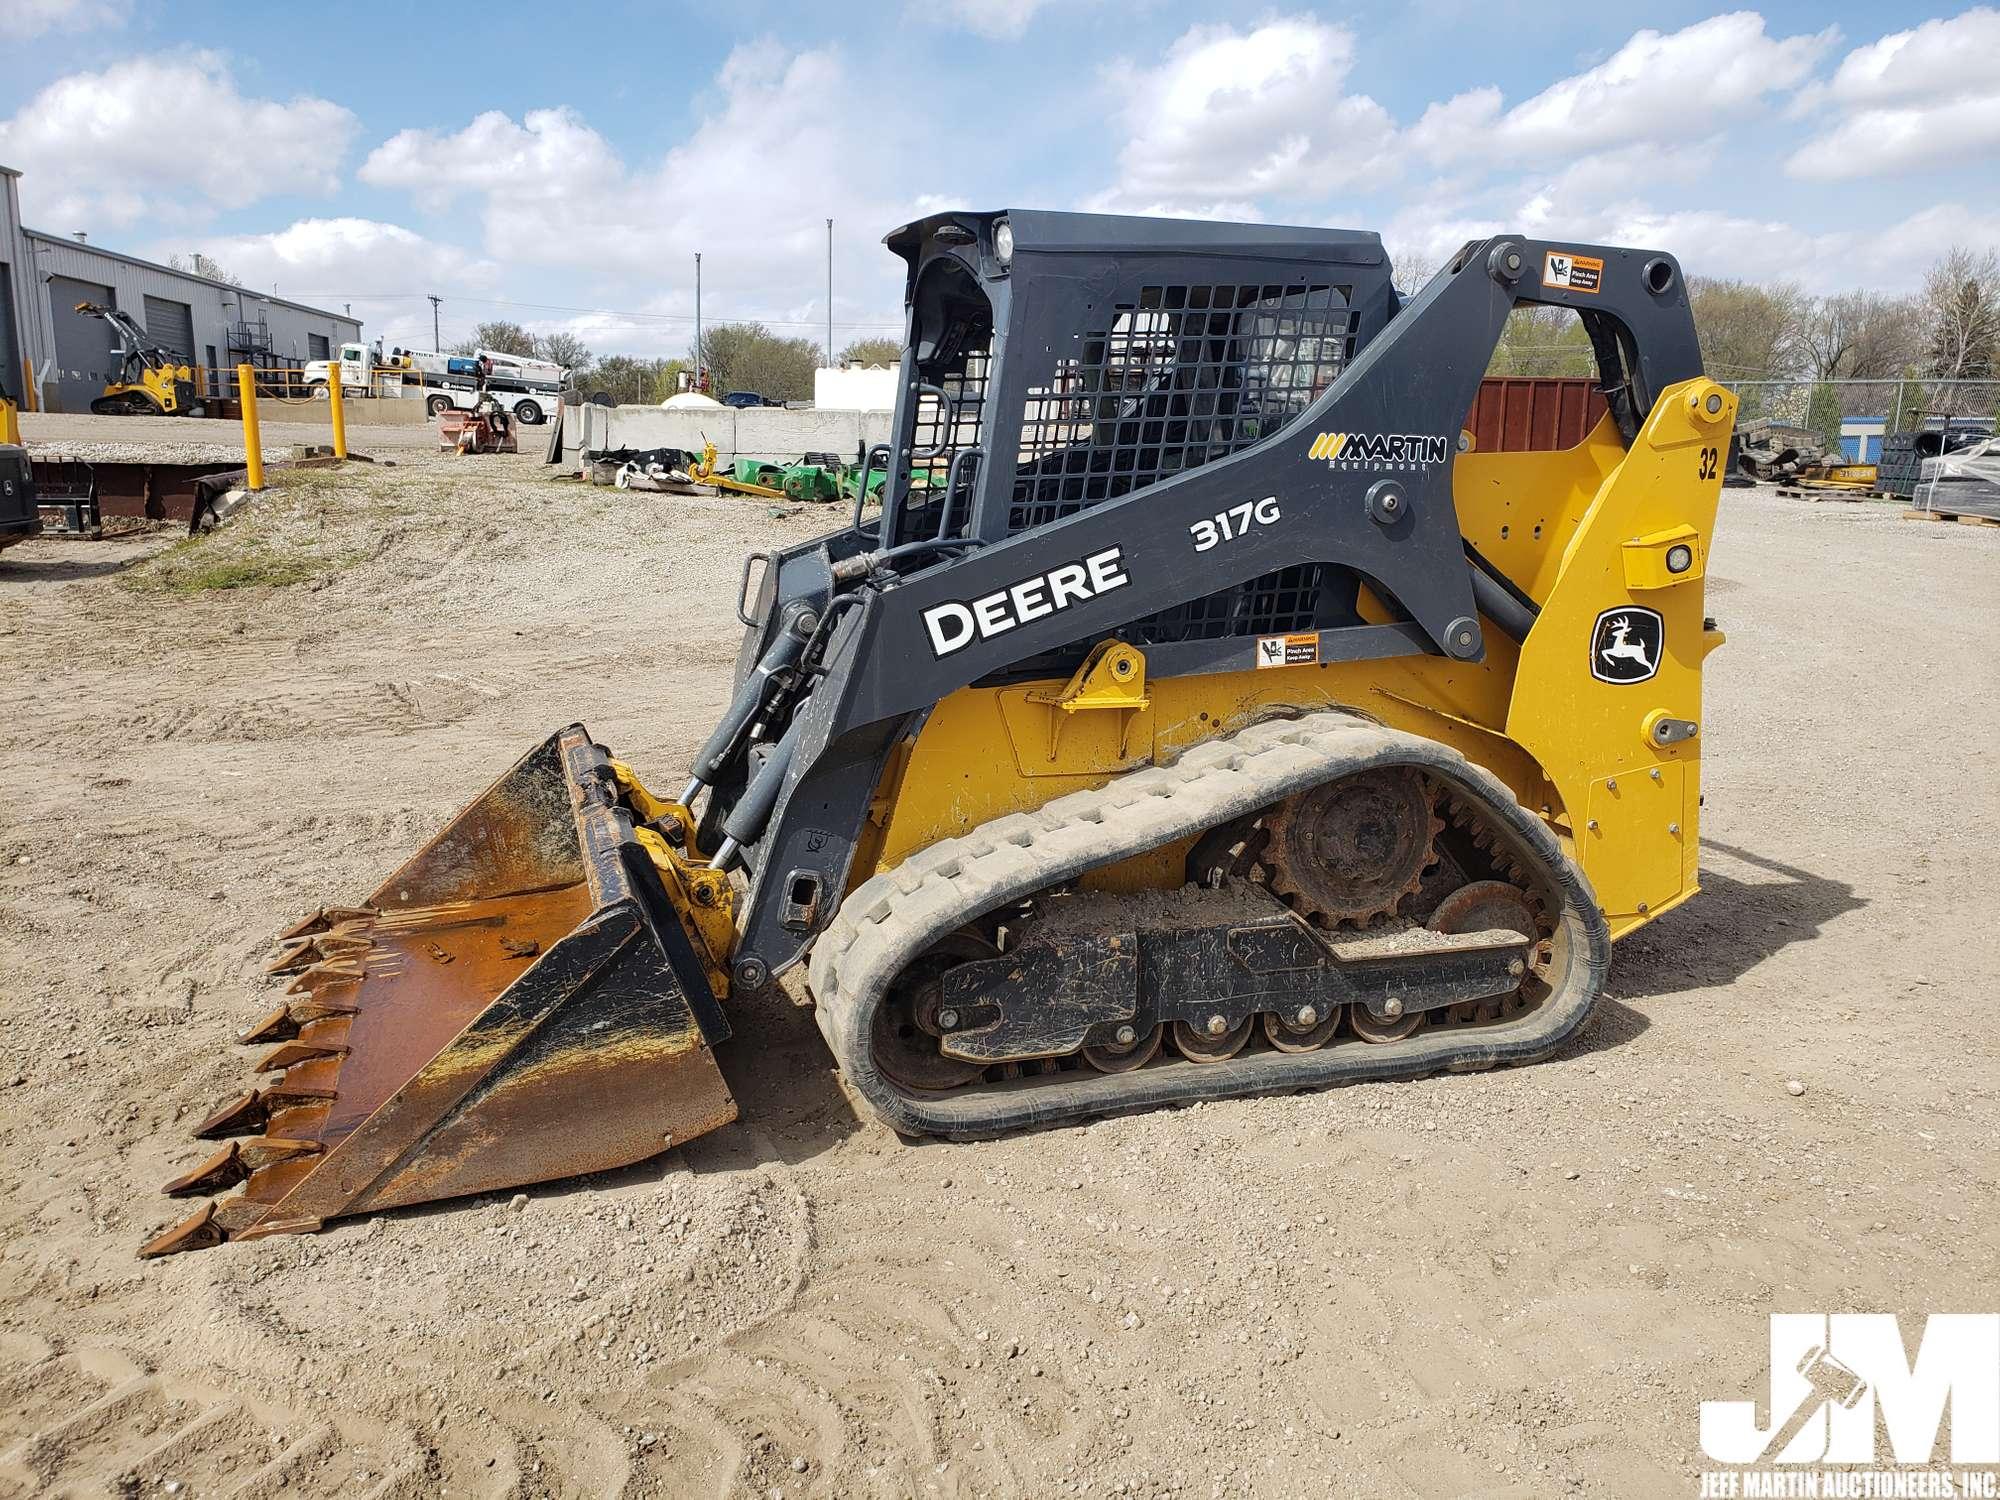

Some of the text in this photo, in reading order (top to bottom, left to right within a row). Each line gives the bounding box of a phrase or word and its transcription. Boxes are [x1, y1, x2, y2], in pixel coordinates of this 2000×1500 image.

[1572, 270, 1598, 280] Pinch Area
[1338, 434, 1447, 463] MARTIN
[1699, 447, 1718, 480] 32
[1189, 496, 1281, 552] 317G
[923, 547, 1128, 656] DEERE
